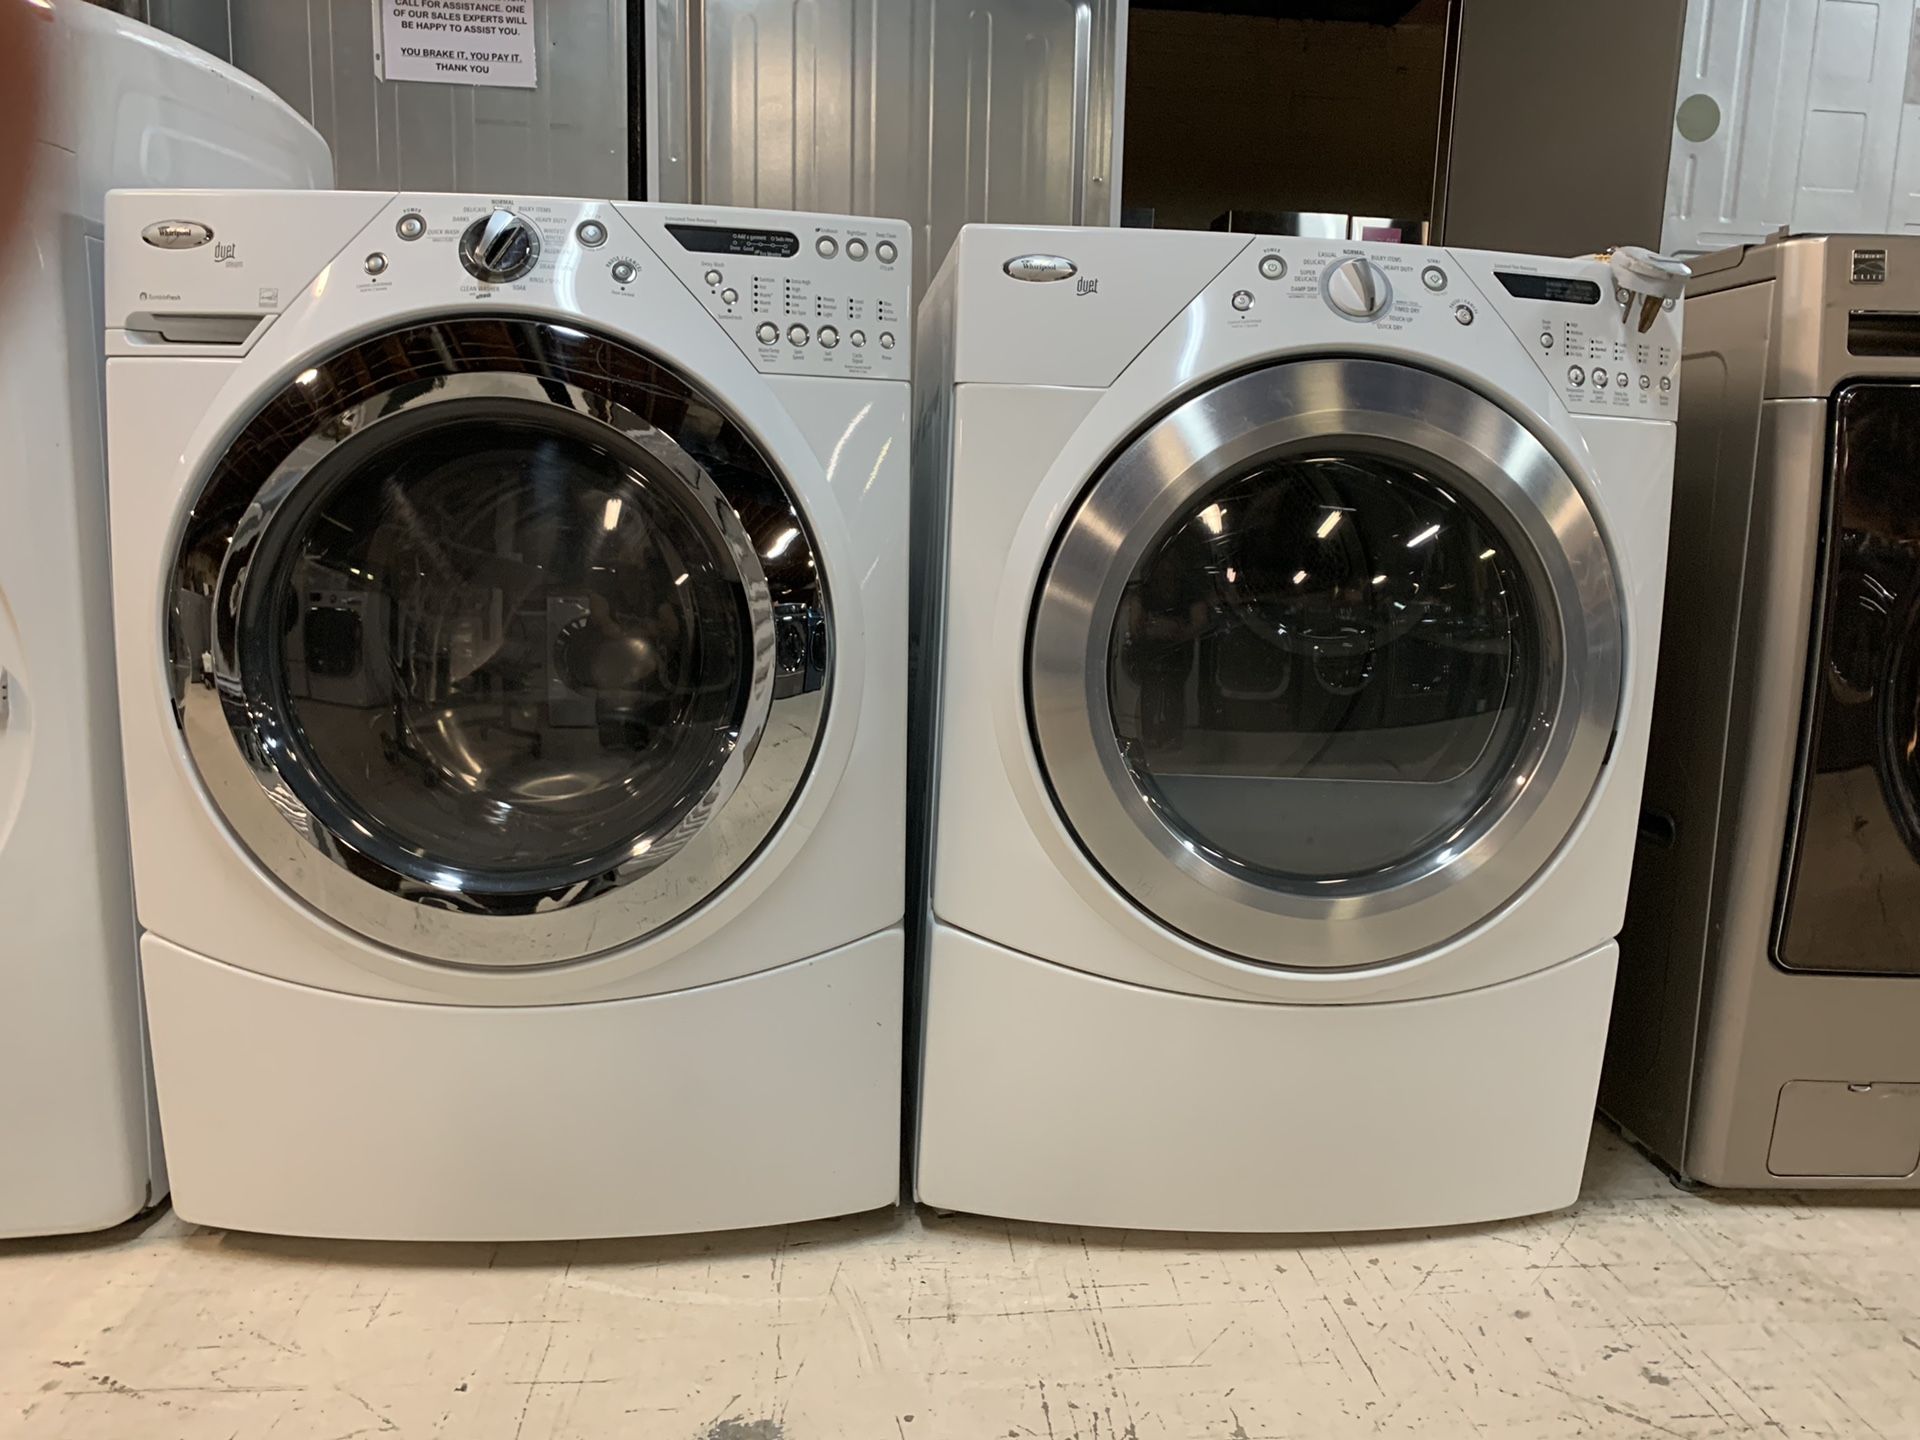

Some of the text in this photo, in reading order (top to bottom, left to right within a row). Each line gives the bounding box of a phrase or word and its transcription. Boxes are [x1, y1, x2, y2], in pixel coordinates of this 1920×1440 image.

[421, 0, 441, 9] FOR
[505, 5, 525, 14] ONE
[393, 9, 528, 25] OF OUR SALES EXPERTS WILL
[401, 21, 521, 36] BE HAPPY TO ASSIST YOU.
[400, 47, 421, 57] YOU
[423, 49, 455, 60] BRAKE
[470, 52, 490, 62] YOU
[491, 53, 510, 63] PAY
[510, 54, 523, 64] IT.
[436, 62, 490, 74] THANK YOU
[213, 241, 237, 263] duet
[1342, 249, 1366, 257] NORMAL
[1021, 259, 1057, 272] Whirlpool
[1075, 275, 1099, 297] duet
